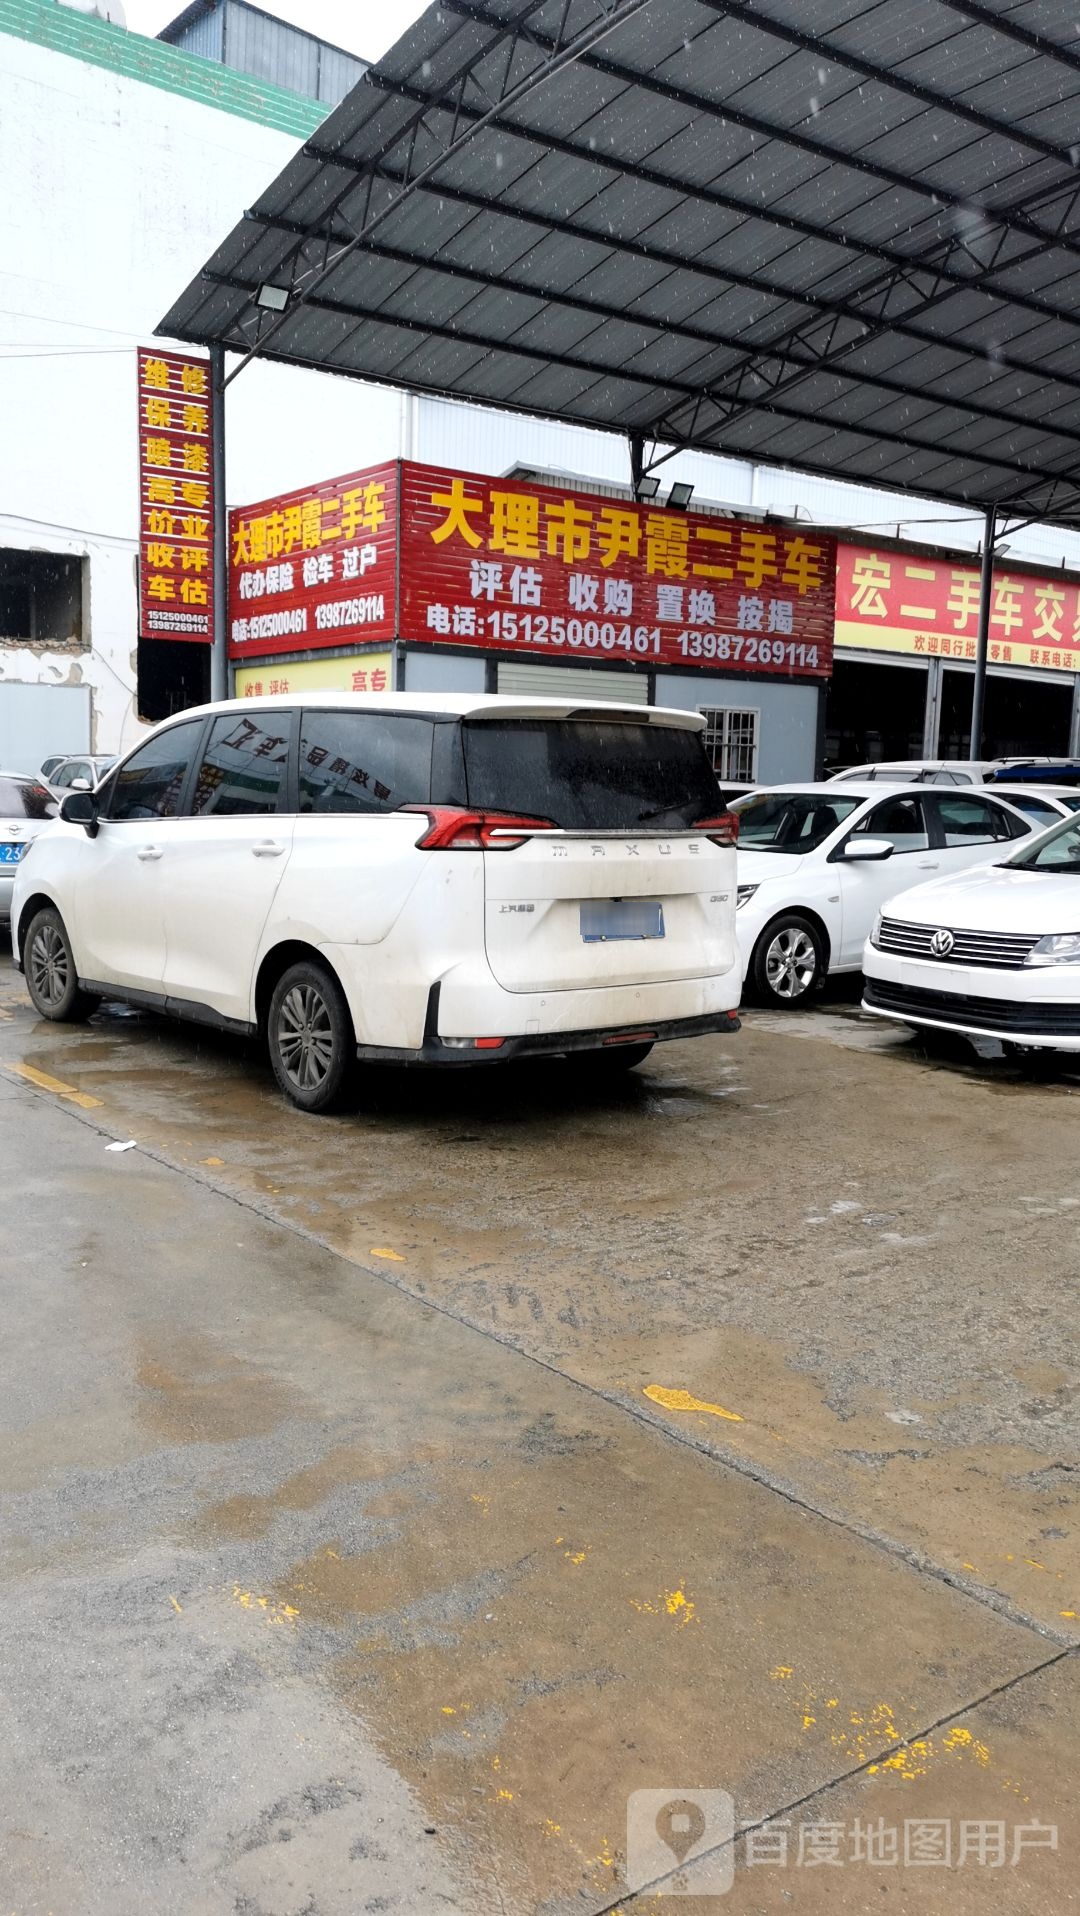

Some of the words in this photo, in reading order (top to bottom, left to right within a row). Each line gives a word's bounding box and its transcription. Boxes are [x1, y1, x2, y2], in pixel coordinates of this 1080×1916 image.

[233, 481, 385, 567] 大理市尹霞二手车
[430, 479, 823, 594] 大理市尹霞二手车
[239, 562, 294, 600] 代办保险
[303, 554, 334, 588] 检车
[342, 543, 377, 580] 过户
[148, 611, 208, 624] 15125000461
[315, 594, 385, 630] 13987269114
[469, 560, 543, 606] 评估
[568, 574, 633, 617] 收购
[656, 584, 717, 627] 置换
[737, 595, 793, 635] 按揭
[835, 553, 1080, 643] 宏二手车交
[147, 620, 208, 633] 13987269114
[677, 630, 819, 668] 13987269114
[914, 635, 1013, 662] 欢迎同行批零售
